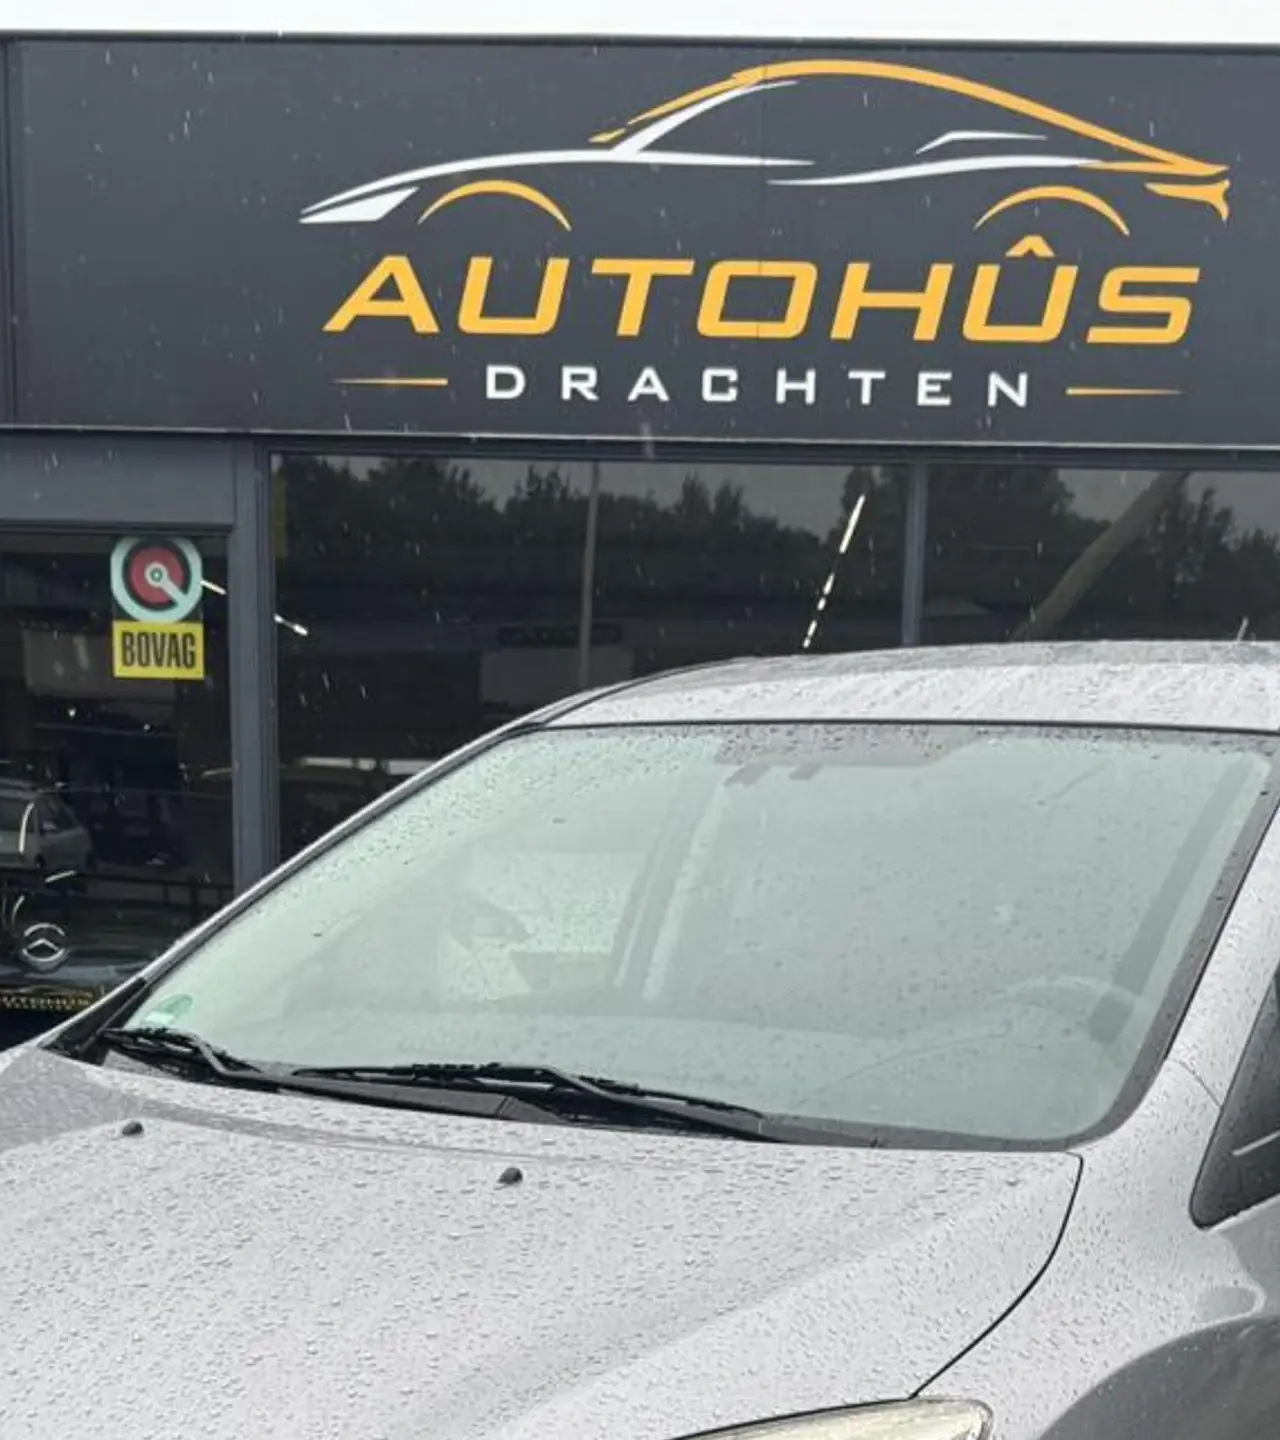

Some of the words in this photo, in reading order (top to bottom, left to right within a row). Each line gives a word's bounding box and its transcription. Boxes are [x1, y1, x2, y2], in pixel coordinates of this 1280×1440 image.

[323, 235, 1200, 344] AUTOHÛS
[485, 365, 1029, 406] DRACHTEN
[121, 631, 197, 669] BOVAG
